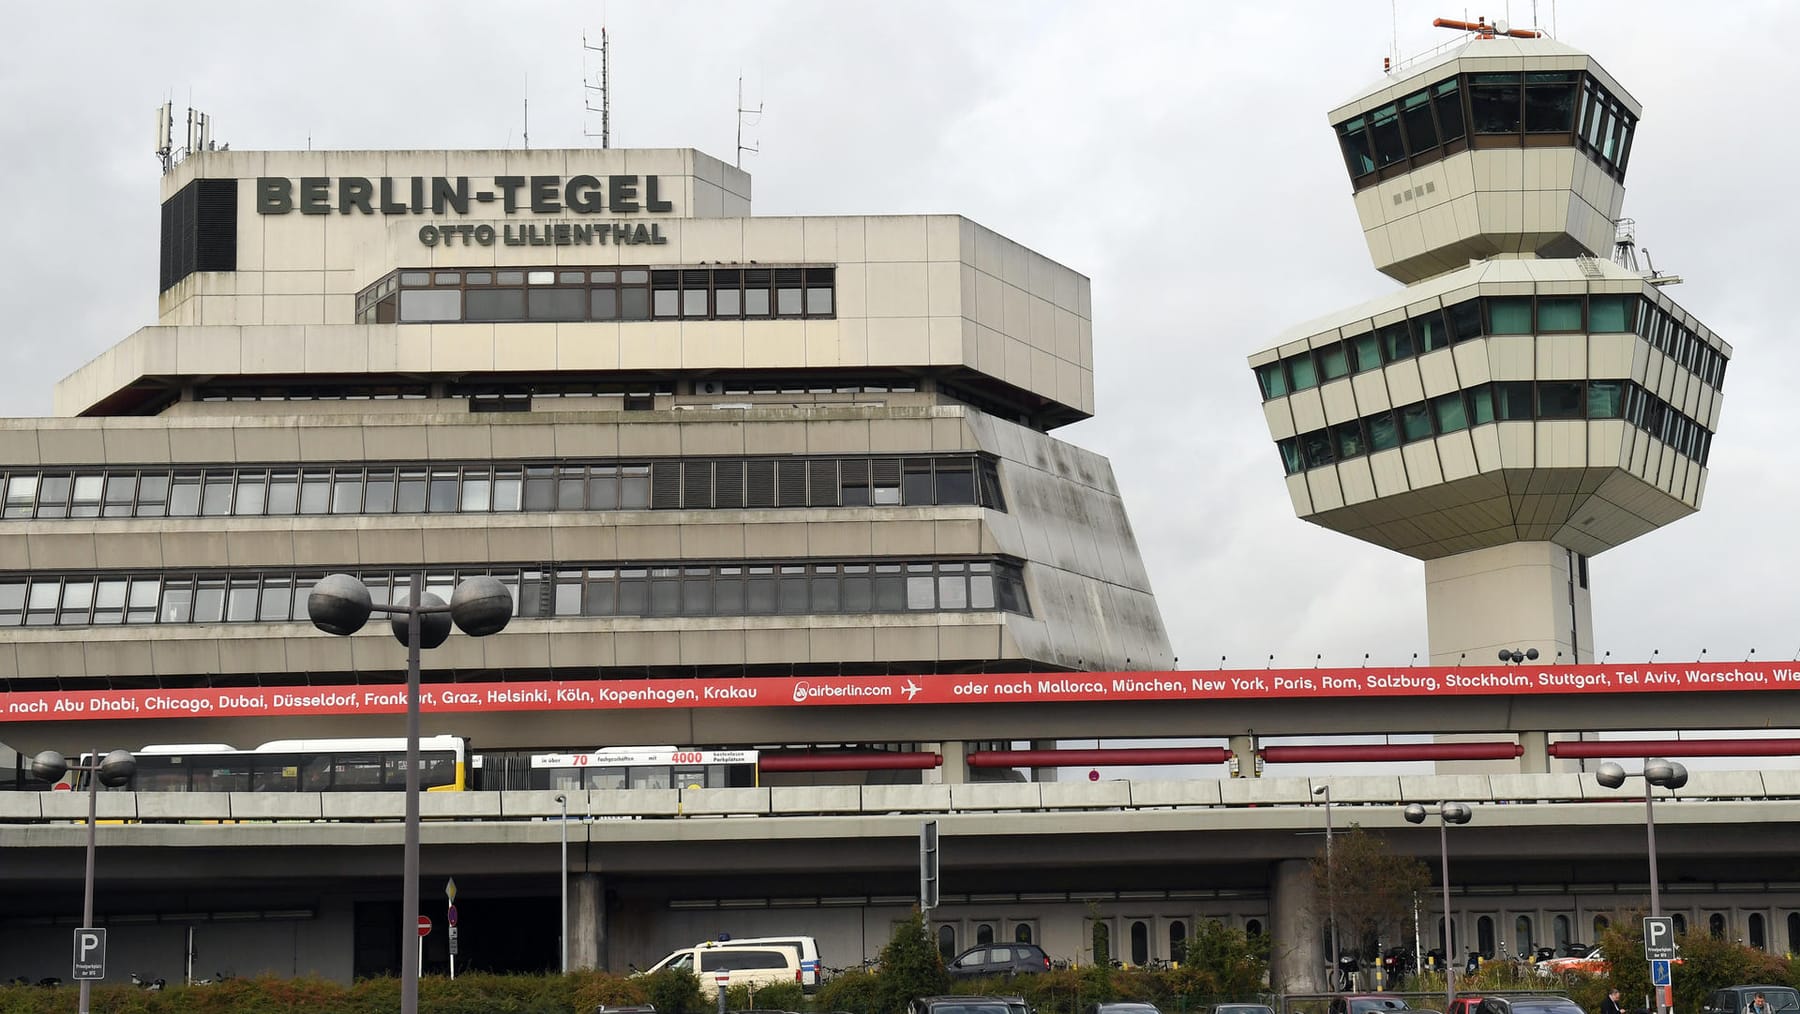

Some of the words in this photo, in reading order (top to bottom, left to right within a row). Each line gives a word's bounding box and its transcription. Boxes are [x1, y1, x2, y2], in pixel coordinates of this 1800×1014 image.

[256, 175, 672, 214] BERLIN-TEGEL
[418, 224, 495, 246] OTTO
[503, 223, 666, 245] LILIENTHAL
[808, 684, 892, 697] airberlin.com
[954, 682, 988, 696] oder
[995, 681, 1031, 695] nach
[1038, 680, 1106, 695] Mallorca,
[1112, 679, 1186, 695] München,
[1193, 678, 1226, 692] New
[1230, 677, 1269, 693] York,
[1274, 676, 1317, 692] Paris,
[1322, 677, 1362, 691] Rom,
[1367, 674, 1441, 692] Salzburg,
[1446, 673, 1533, 689] Stockholm,
[1539, 672, 1611, 689] Stuttgart,
[1616, 671, 1639, 685] Tel
[1644, 671, 1681, 686] Aviv,
[1685, 669, 1768, 684] Warschau,
[9, 699, 48, 713] nach
[54, 699, 84, 712] Abu
[90, 697, 139, 713] Dhabi,
[145, 697, 213, 713] Chicago,
[219, 694, 268, 710] Dubai,
[274, 692, 359, 708] Düsseldorf,
[442, 690, 482, 705] Graz,
[488, 688, 552, 704] Helsinki,
[557, 688, 594, 703] Köln,
[600, 686, 698, 704] Kopenhagen,
[704, 685, 757, 699] Krakau
[572, 755, 588, 766] 70
[672, 752, 703, 763] 4000
[1650, 921, 1666, 946] P
[81, 933, 99, 962] P
